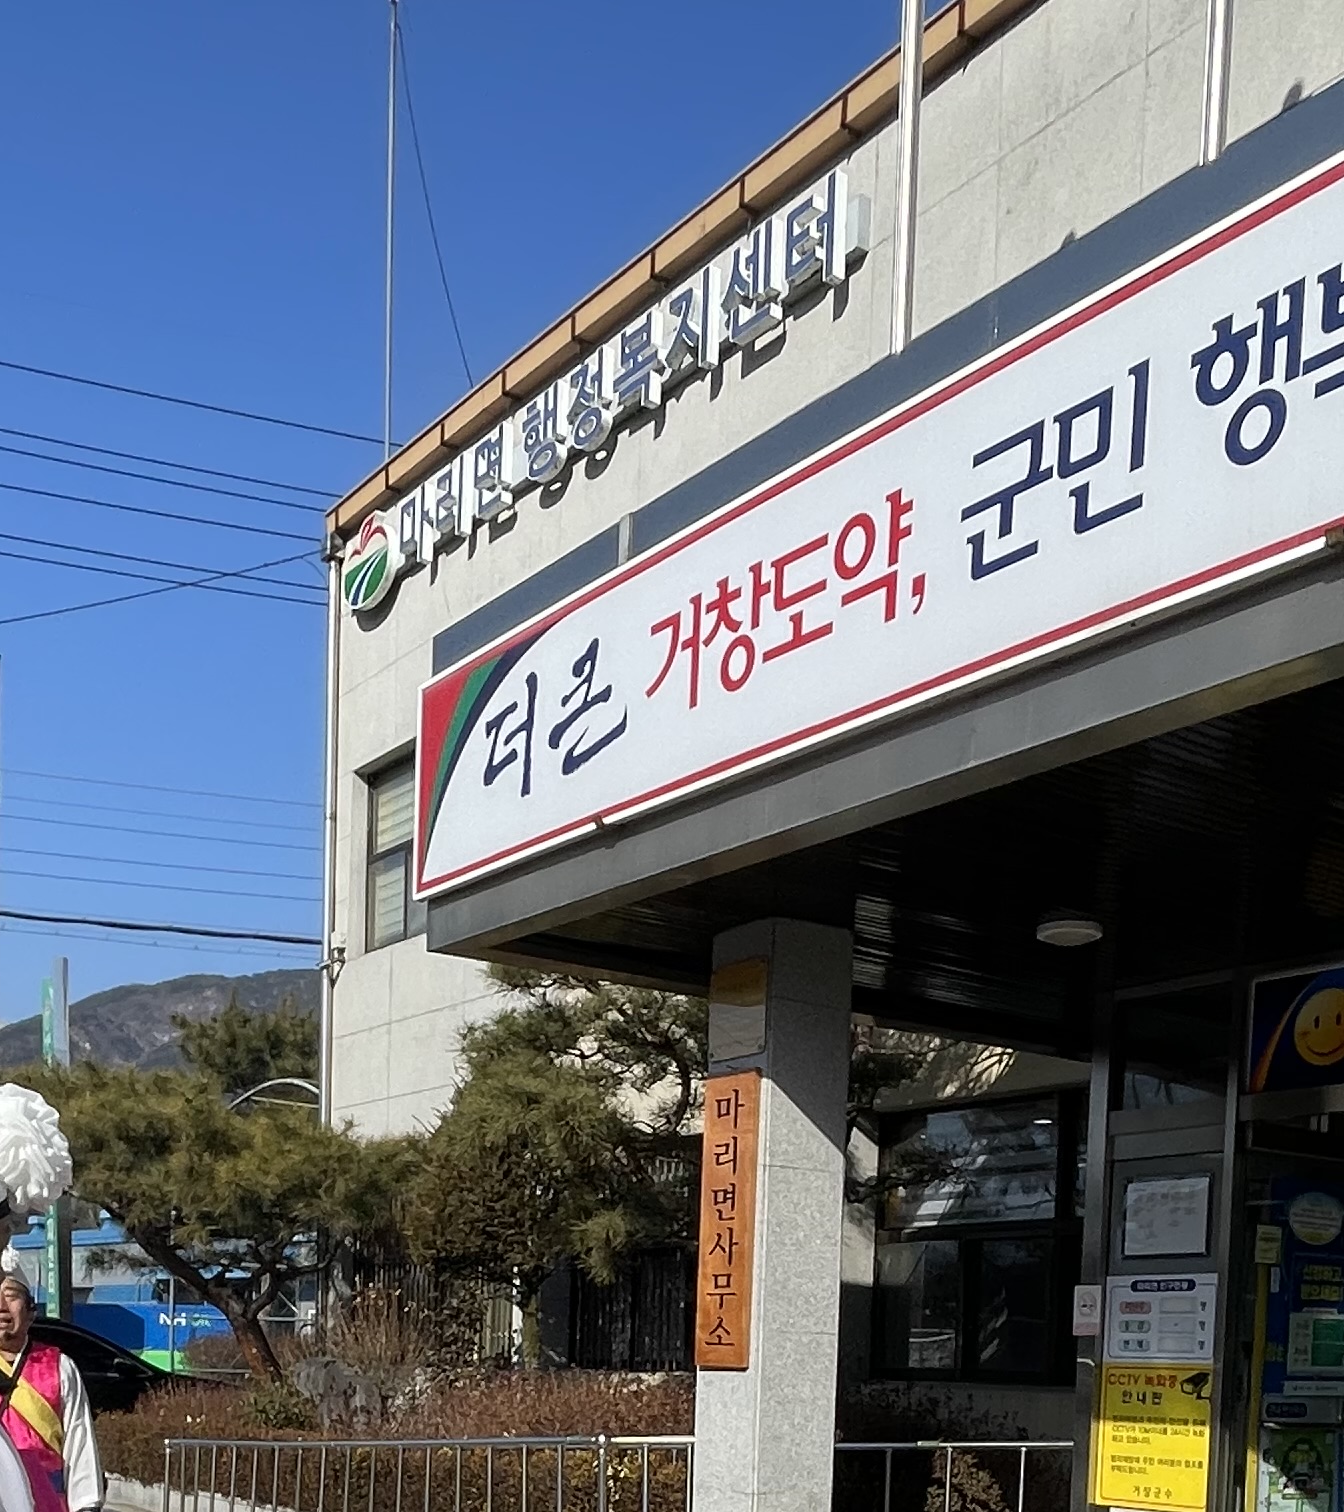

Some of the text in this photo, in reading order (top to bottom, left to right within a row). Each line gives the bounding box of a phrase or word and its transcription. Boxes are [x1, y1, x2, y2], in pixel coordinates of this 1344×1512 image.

[399, 167, 849, 565] 마리면 행정복지센터
[481, 671, 533, 797] 더
[548, 637, 628, 776] 큰
[645, 488, 926, 708] 거창도약,
[960, 361, 1150, 582] 군민
[704, 1088, 746, 1348] 마리면사무소
[1108, 1373, 1141, 1385] CCTV
